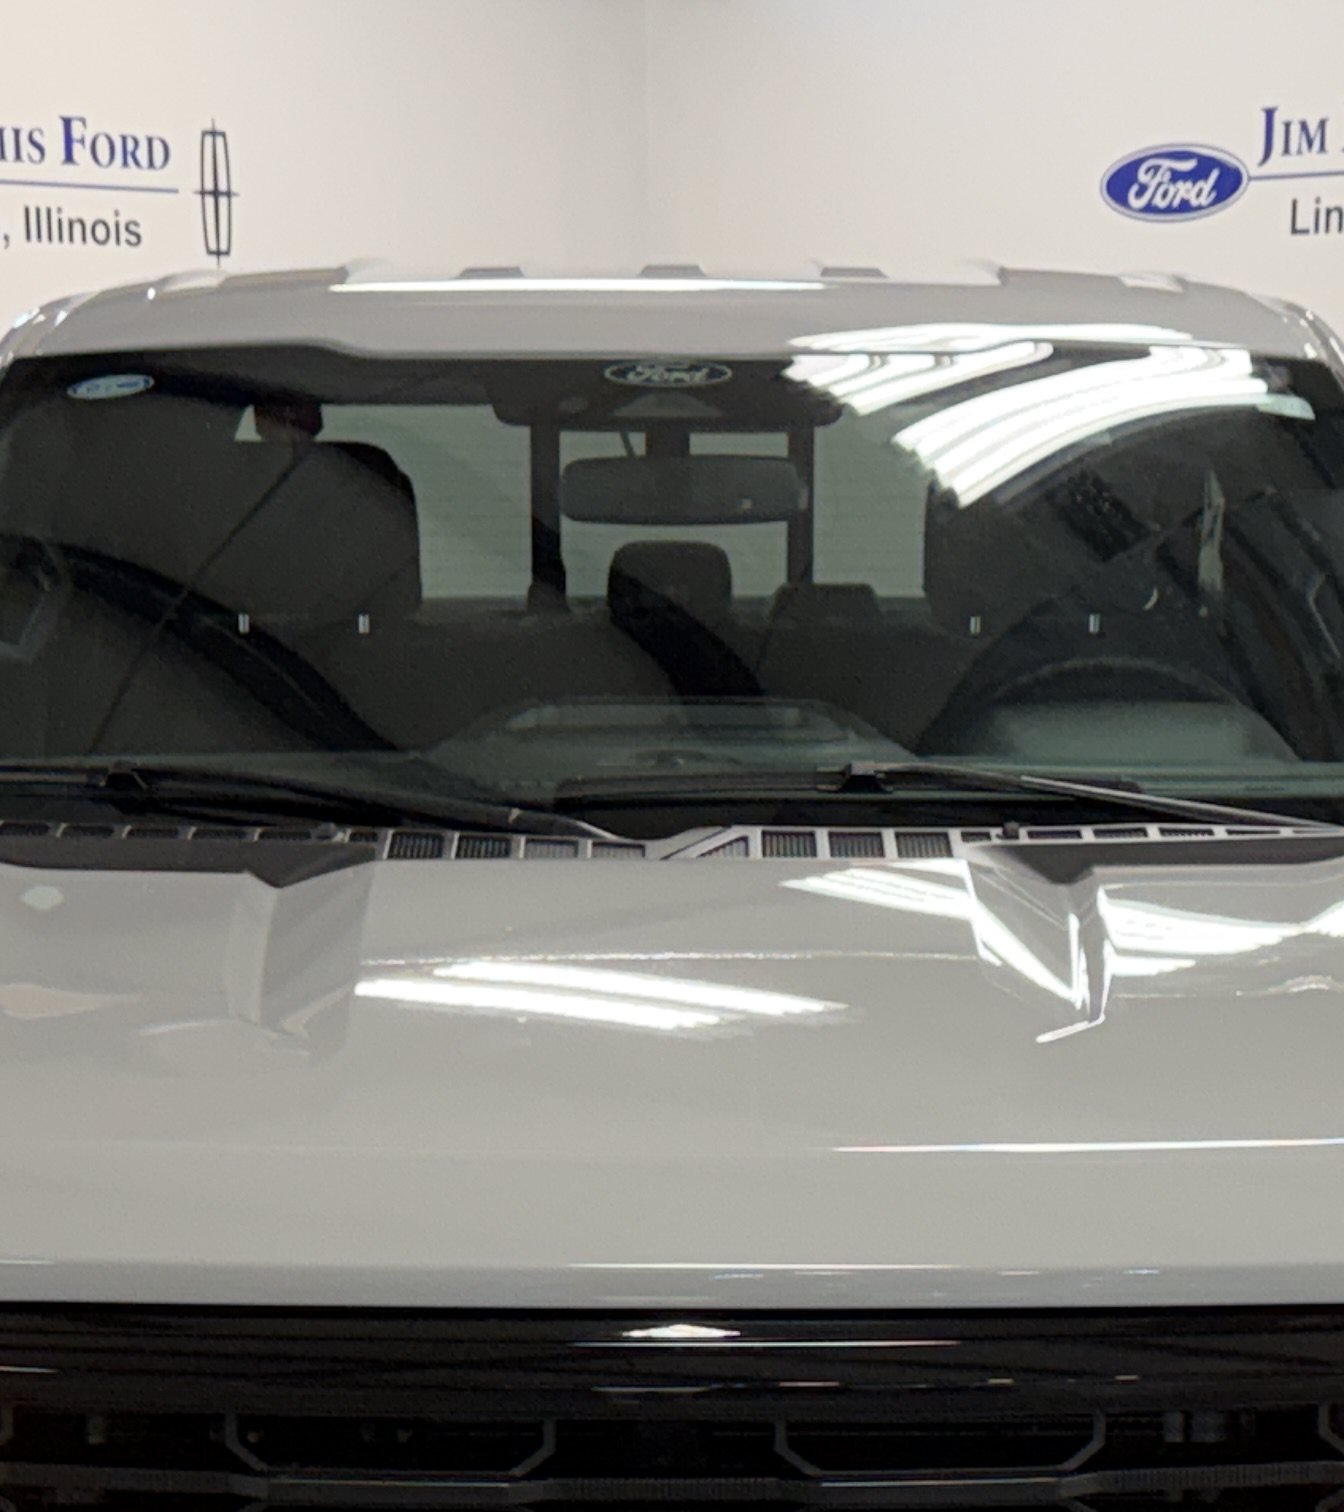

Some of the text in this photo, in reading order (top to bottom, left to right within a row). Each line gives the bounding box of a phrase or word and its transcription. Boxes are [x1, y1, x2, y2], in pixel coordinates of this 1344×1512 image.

[59, 114, 171, 170] FORD
[1258, 106, 1328, 166] JIM
[1128, 158, 1217, 211] Ford
[23, 206, 143, 248] Illinois
